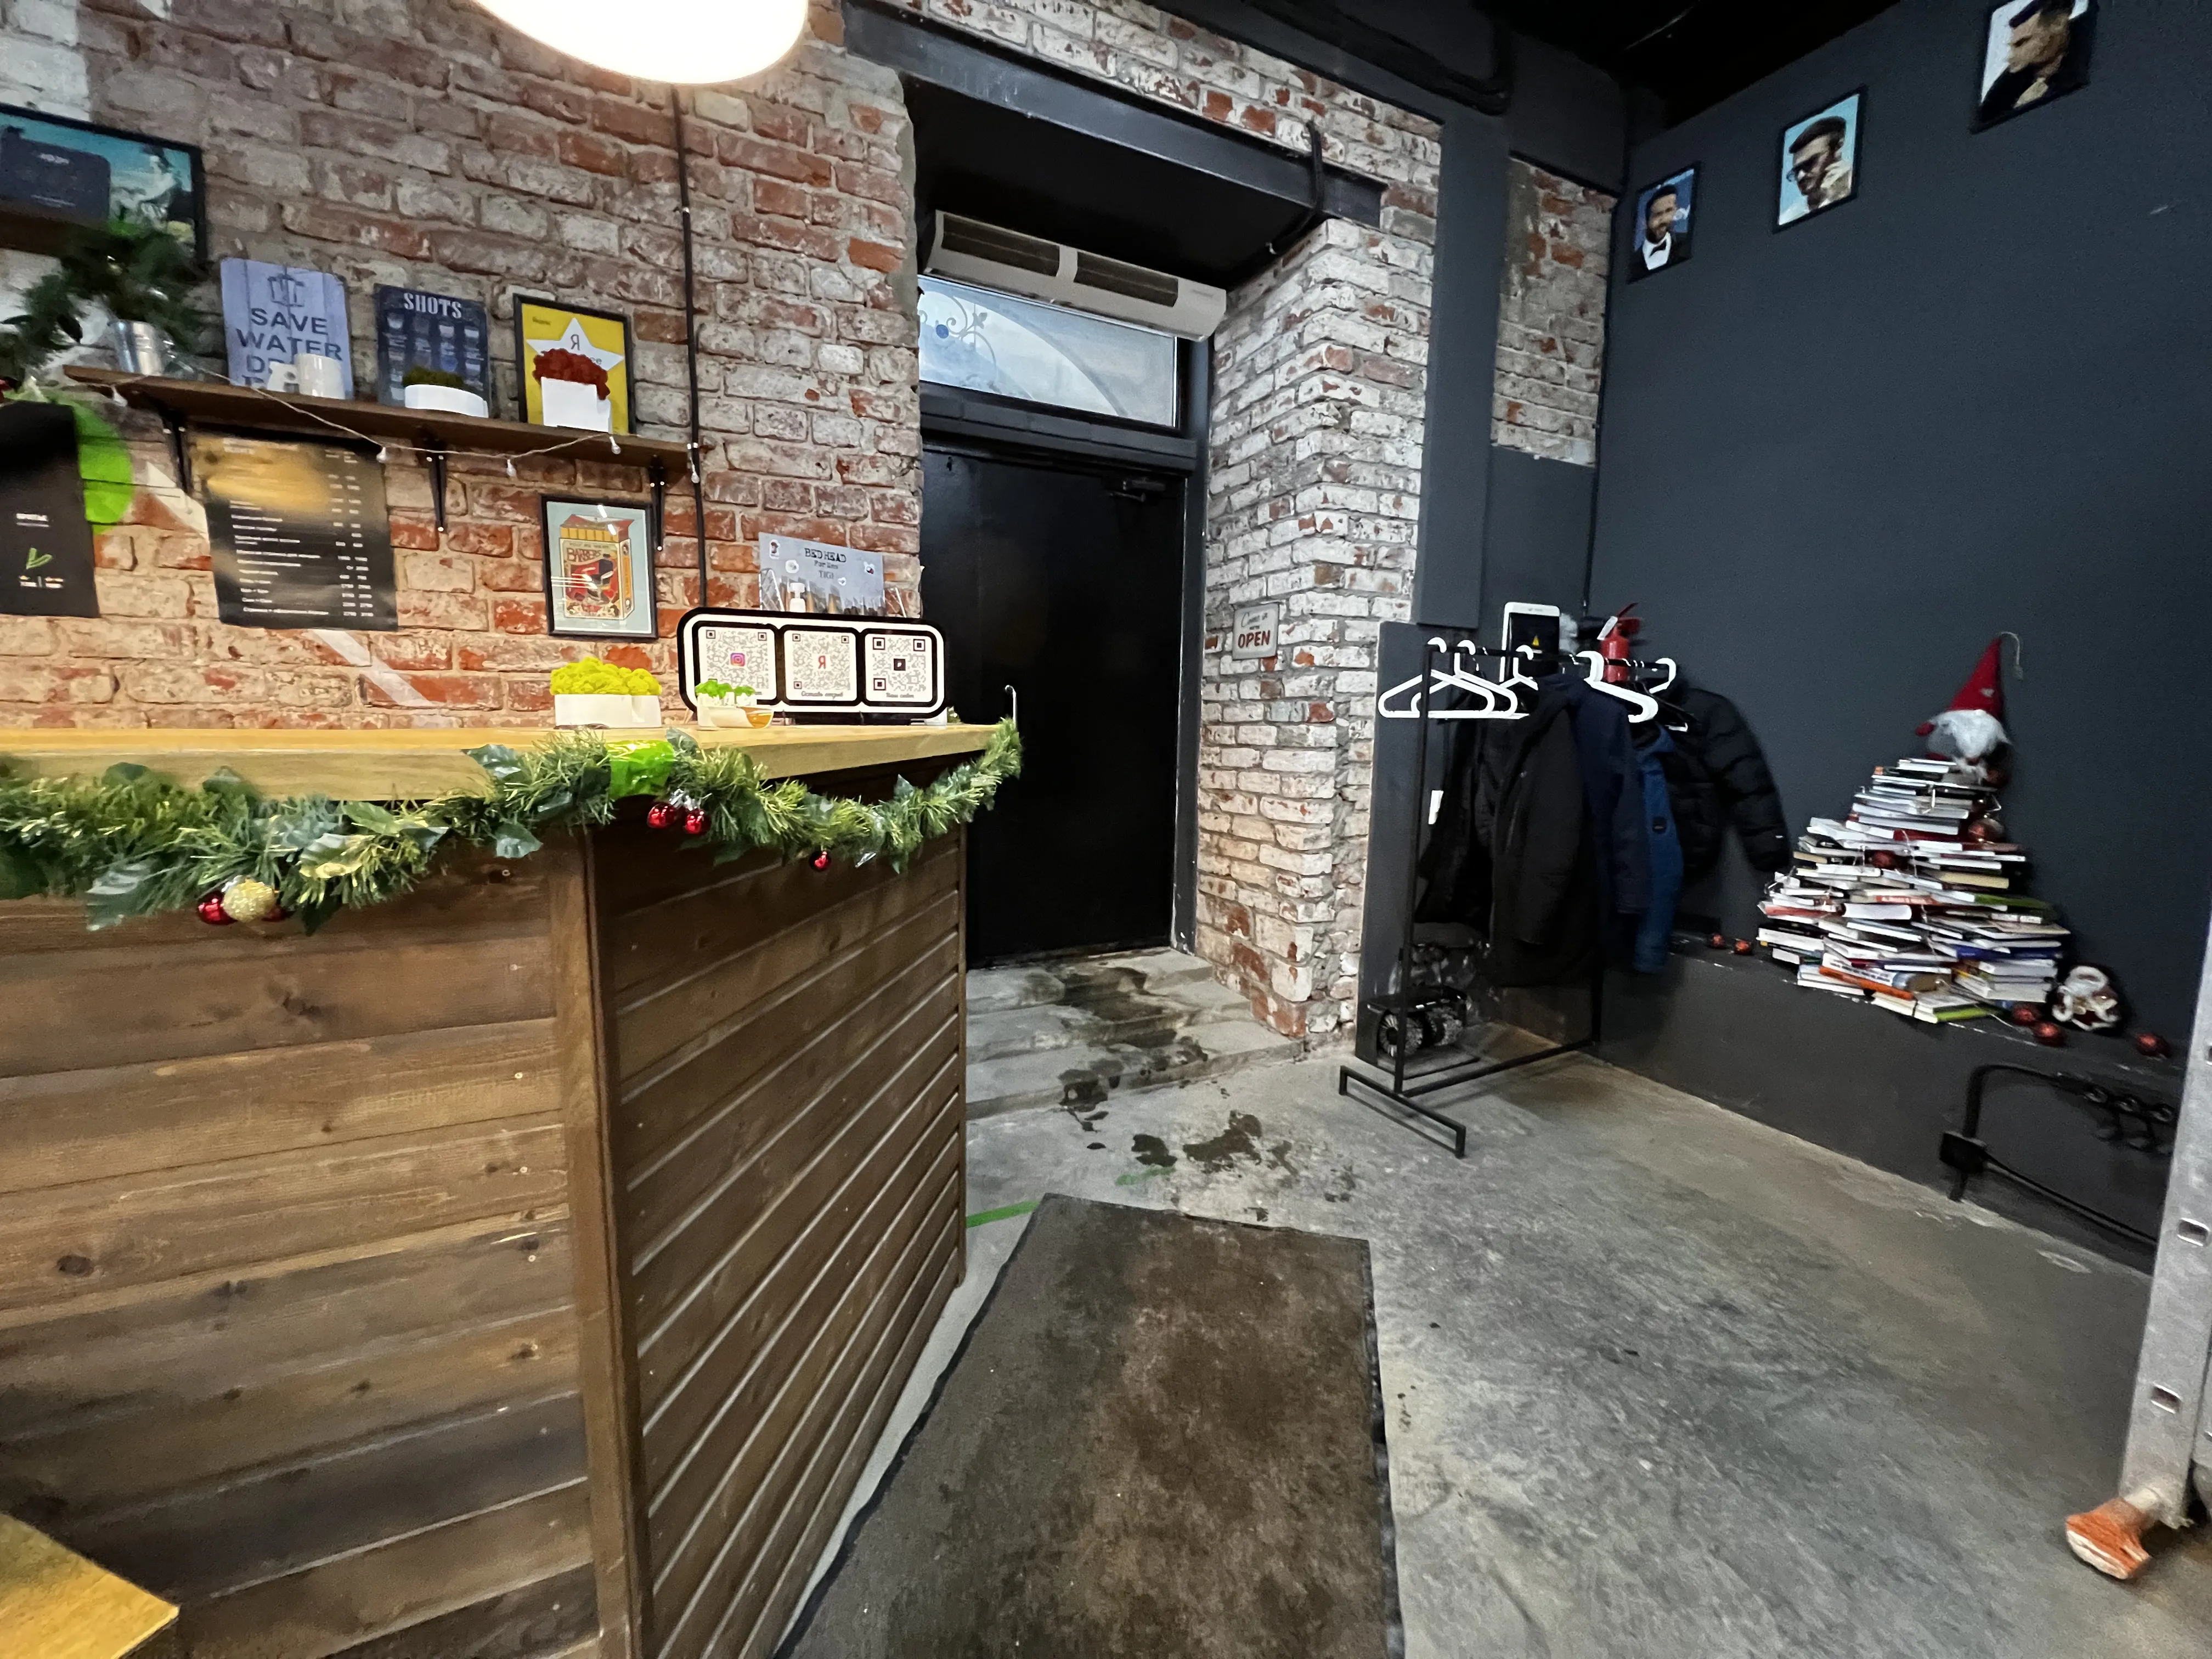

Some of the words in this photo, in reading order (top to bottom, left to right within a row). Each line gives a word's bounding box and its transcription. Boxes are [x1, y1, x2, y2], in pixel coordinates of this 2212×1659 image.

[403, 292, 462, 319] SHOTS
[251, 308, 329, 335] SAVE
[236, 328, 343, 361] WATER
[571, 334, 580, 351] Я
[804, 548, 823, 559] BED
[824, 551, 847, 563] HEAD
[1238, 630, 1271, 648] OPEN
